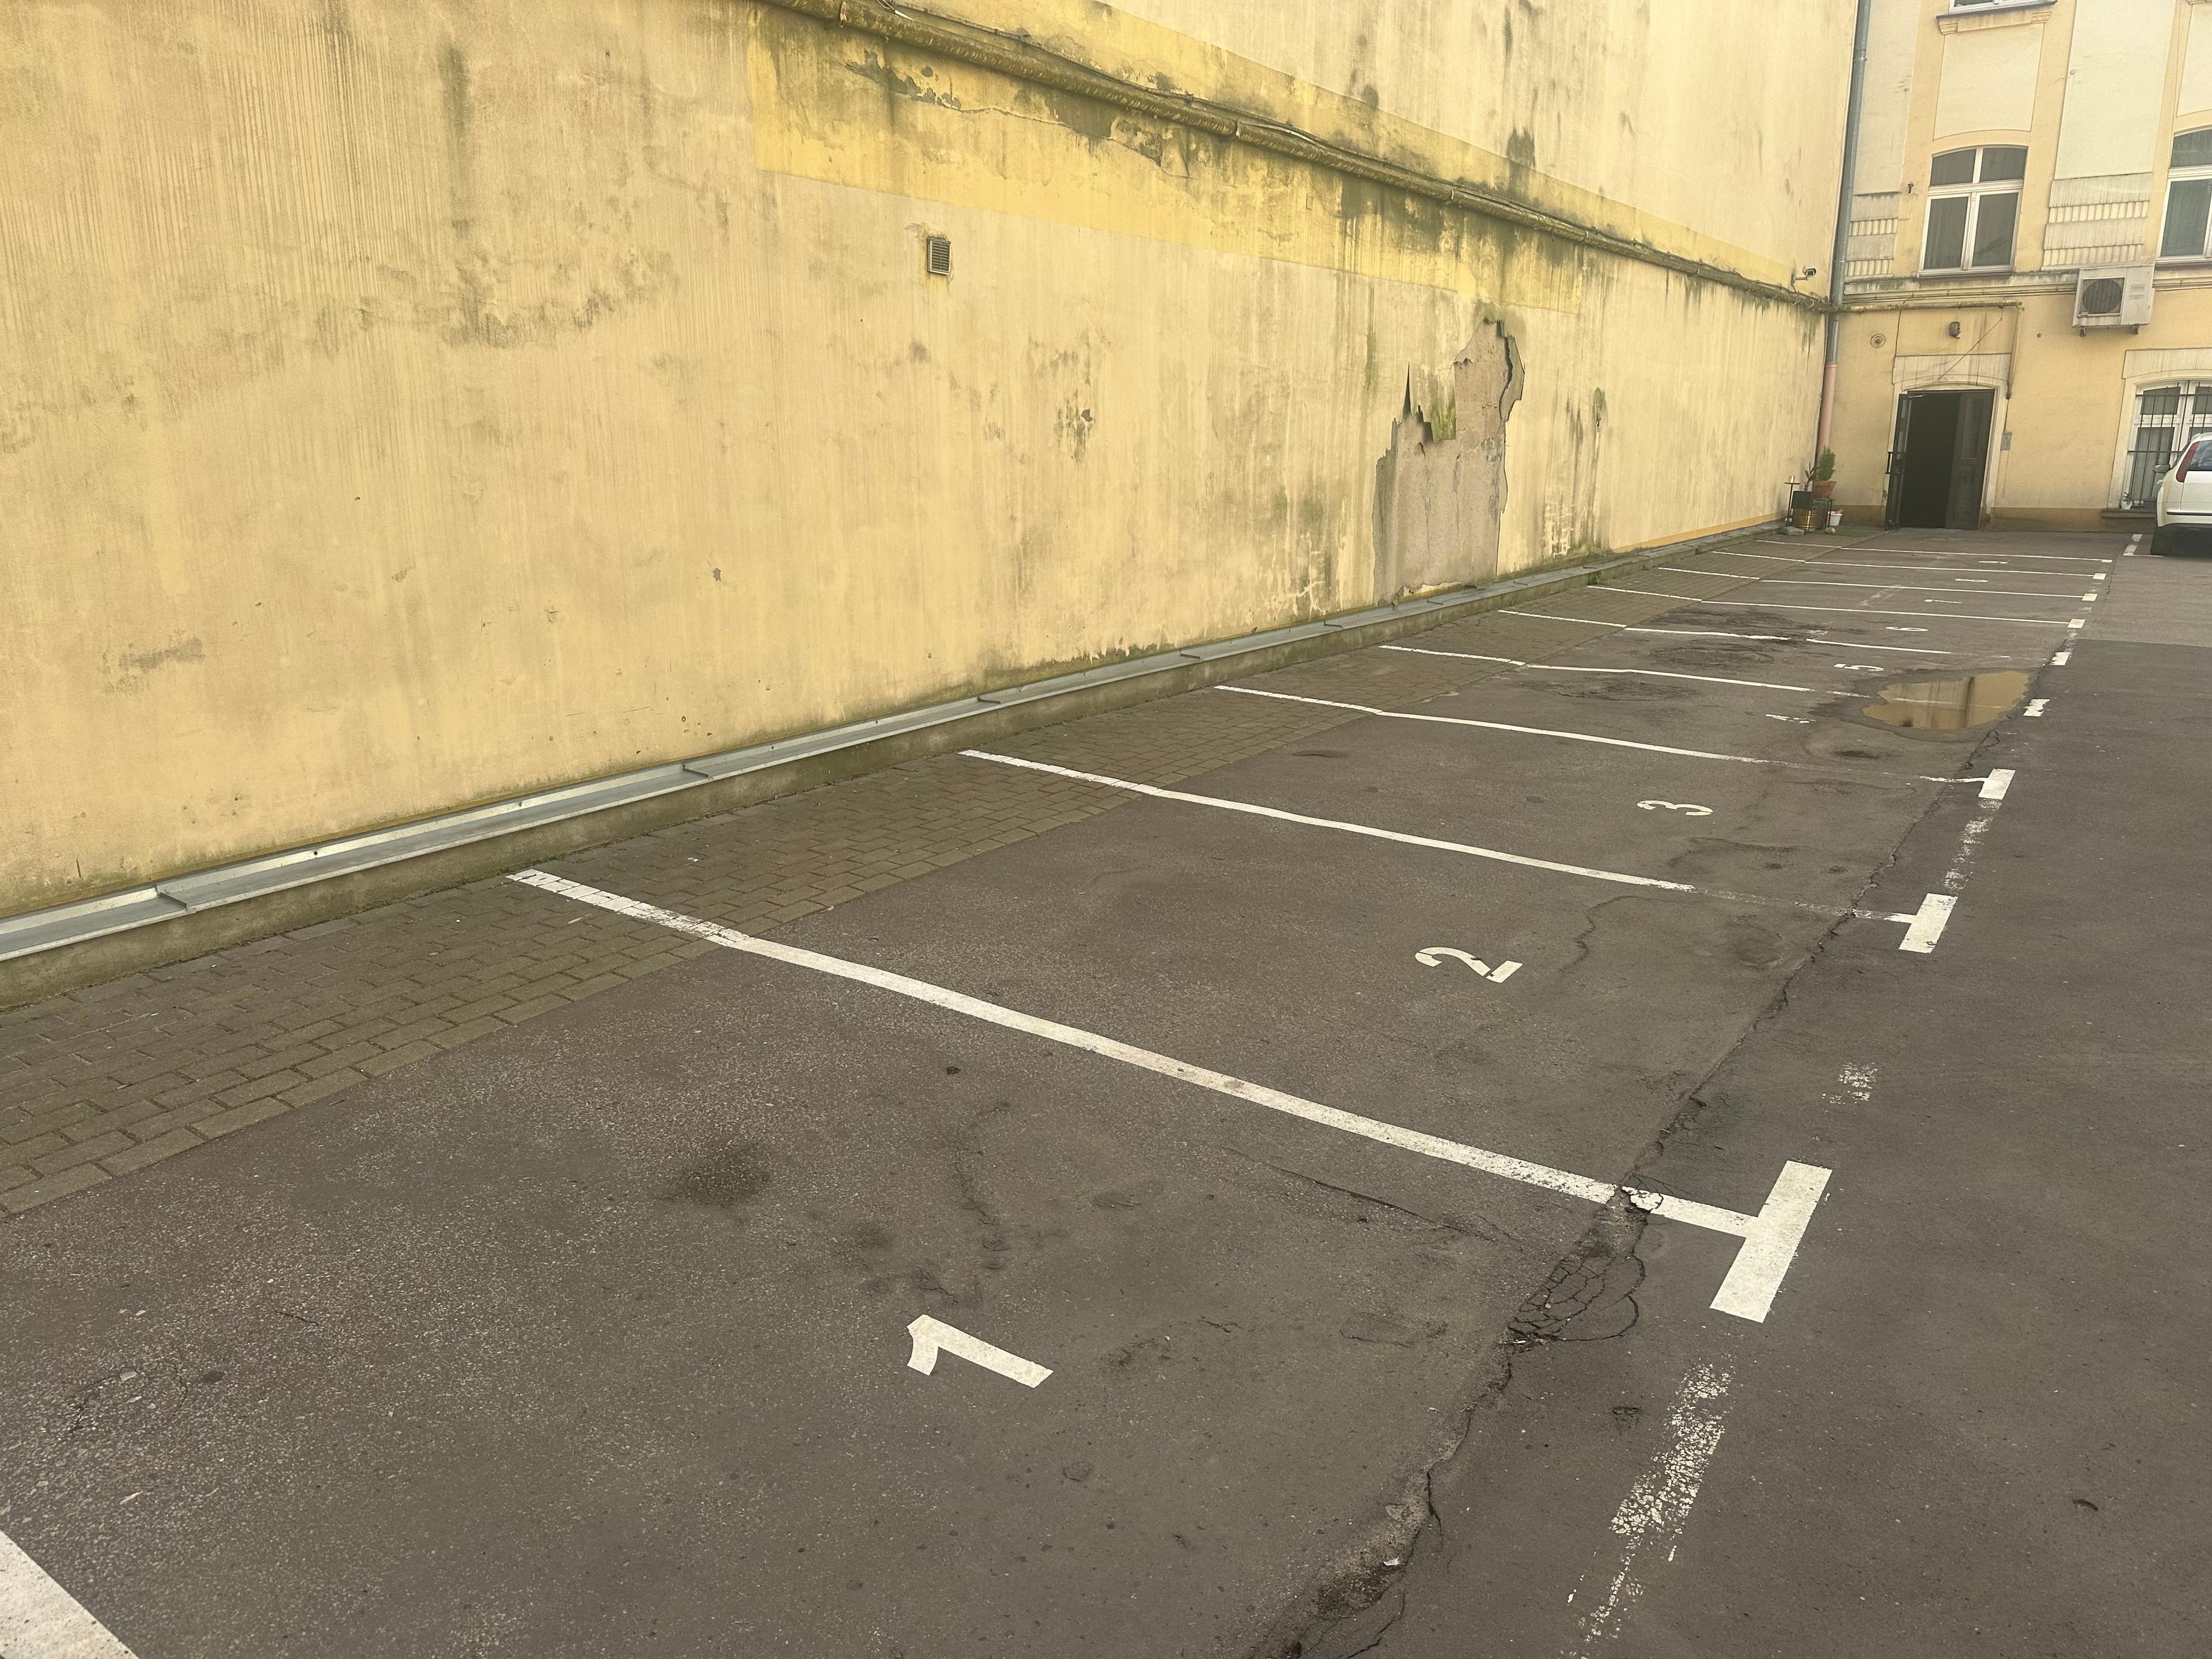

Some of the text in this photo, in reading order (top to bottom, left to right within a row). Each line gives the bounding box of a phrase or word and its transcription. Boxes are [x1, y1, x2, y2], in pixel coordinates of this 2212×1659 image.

[1834, 663, 1884, 671] 5
[1637, 800, 1713, 816] 3
[1415, 946, 1523, 983] 2
[907, 1314, 1054, 1388] 1
